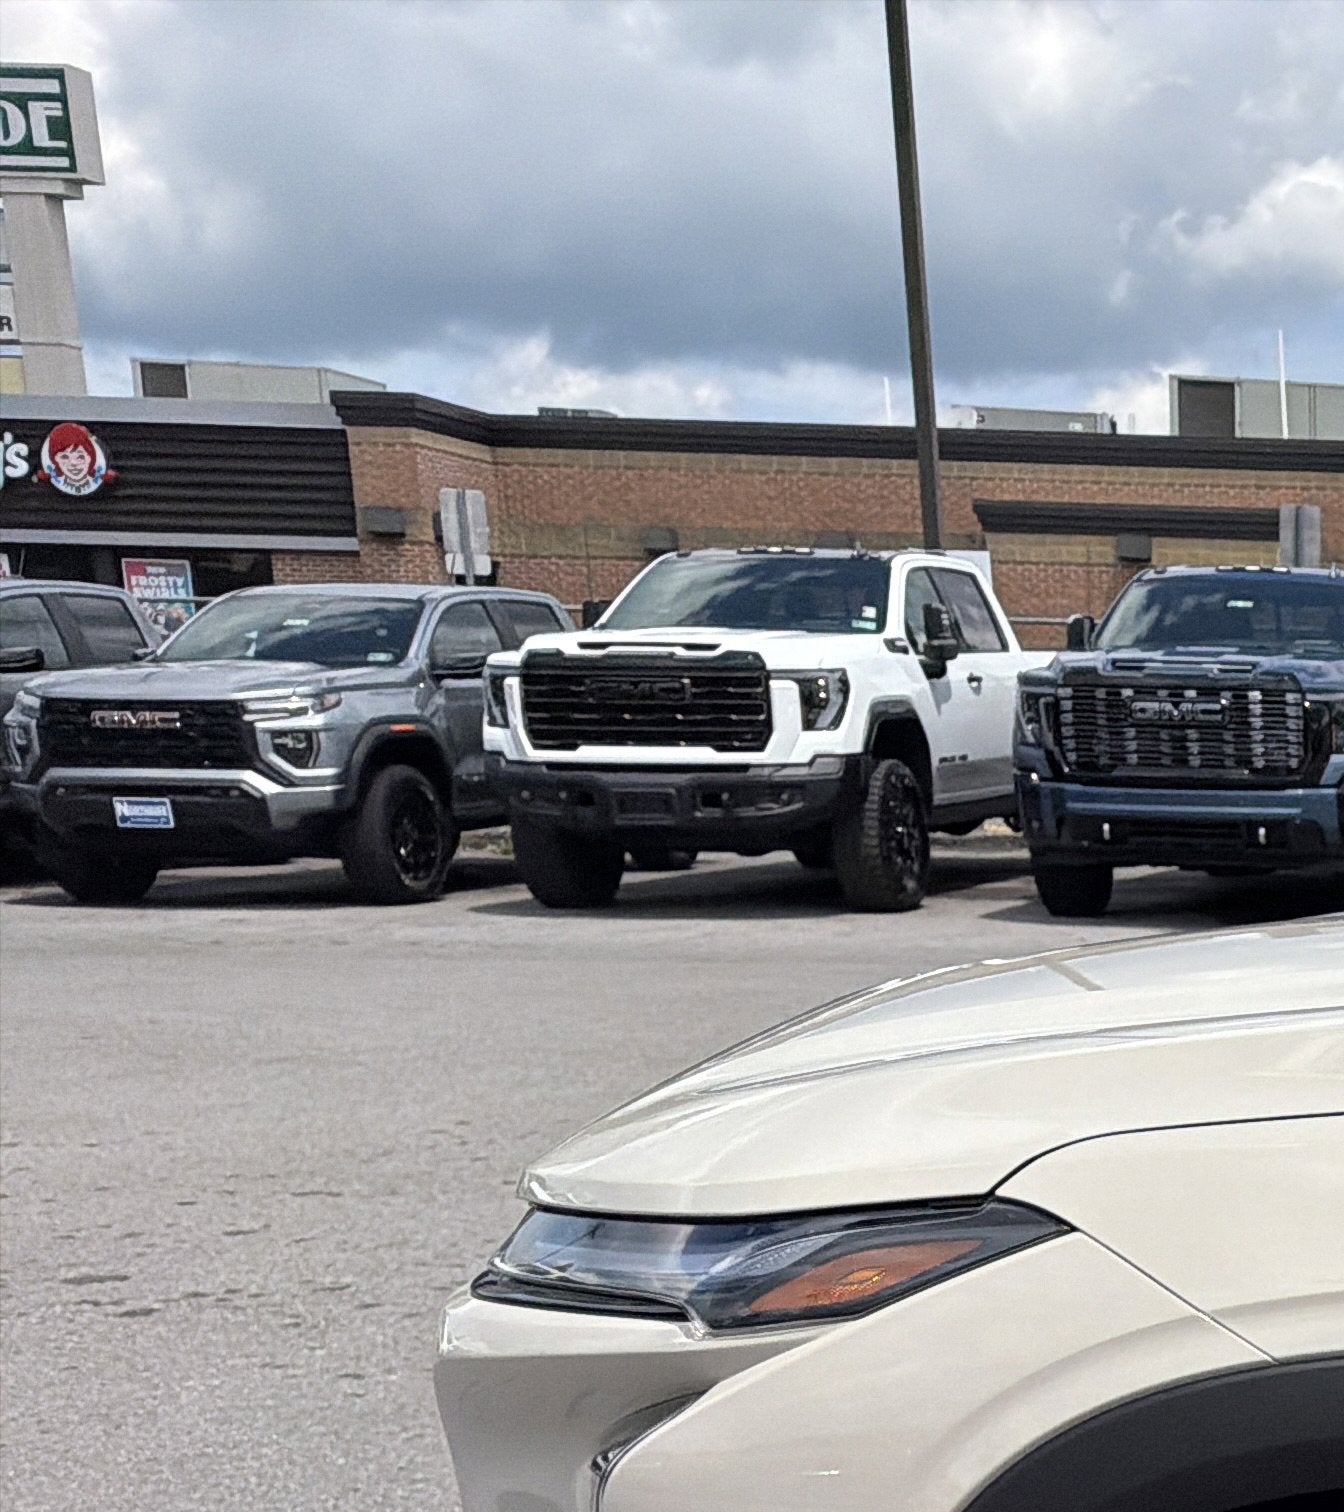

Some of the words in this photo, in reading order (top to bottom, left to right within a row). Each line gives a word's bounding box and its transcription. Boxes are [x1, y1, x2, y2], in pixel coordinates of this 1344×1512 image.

[130, 575, 185, 586] FROSTY
[90, 710, 180, 729] GMC
[1131, 701, 1223, 721] GMC
